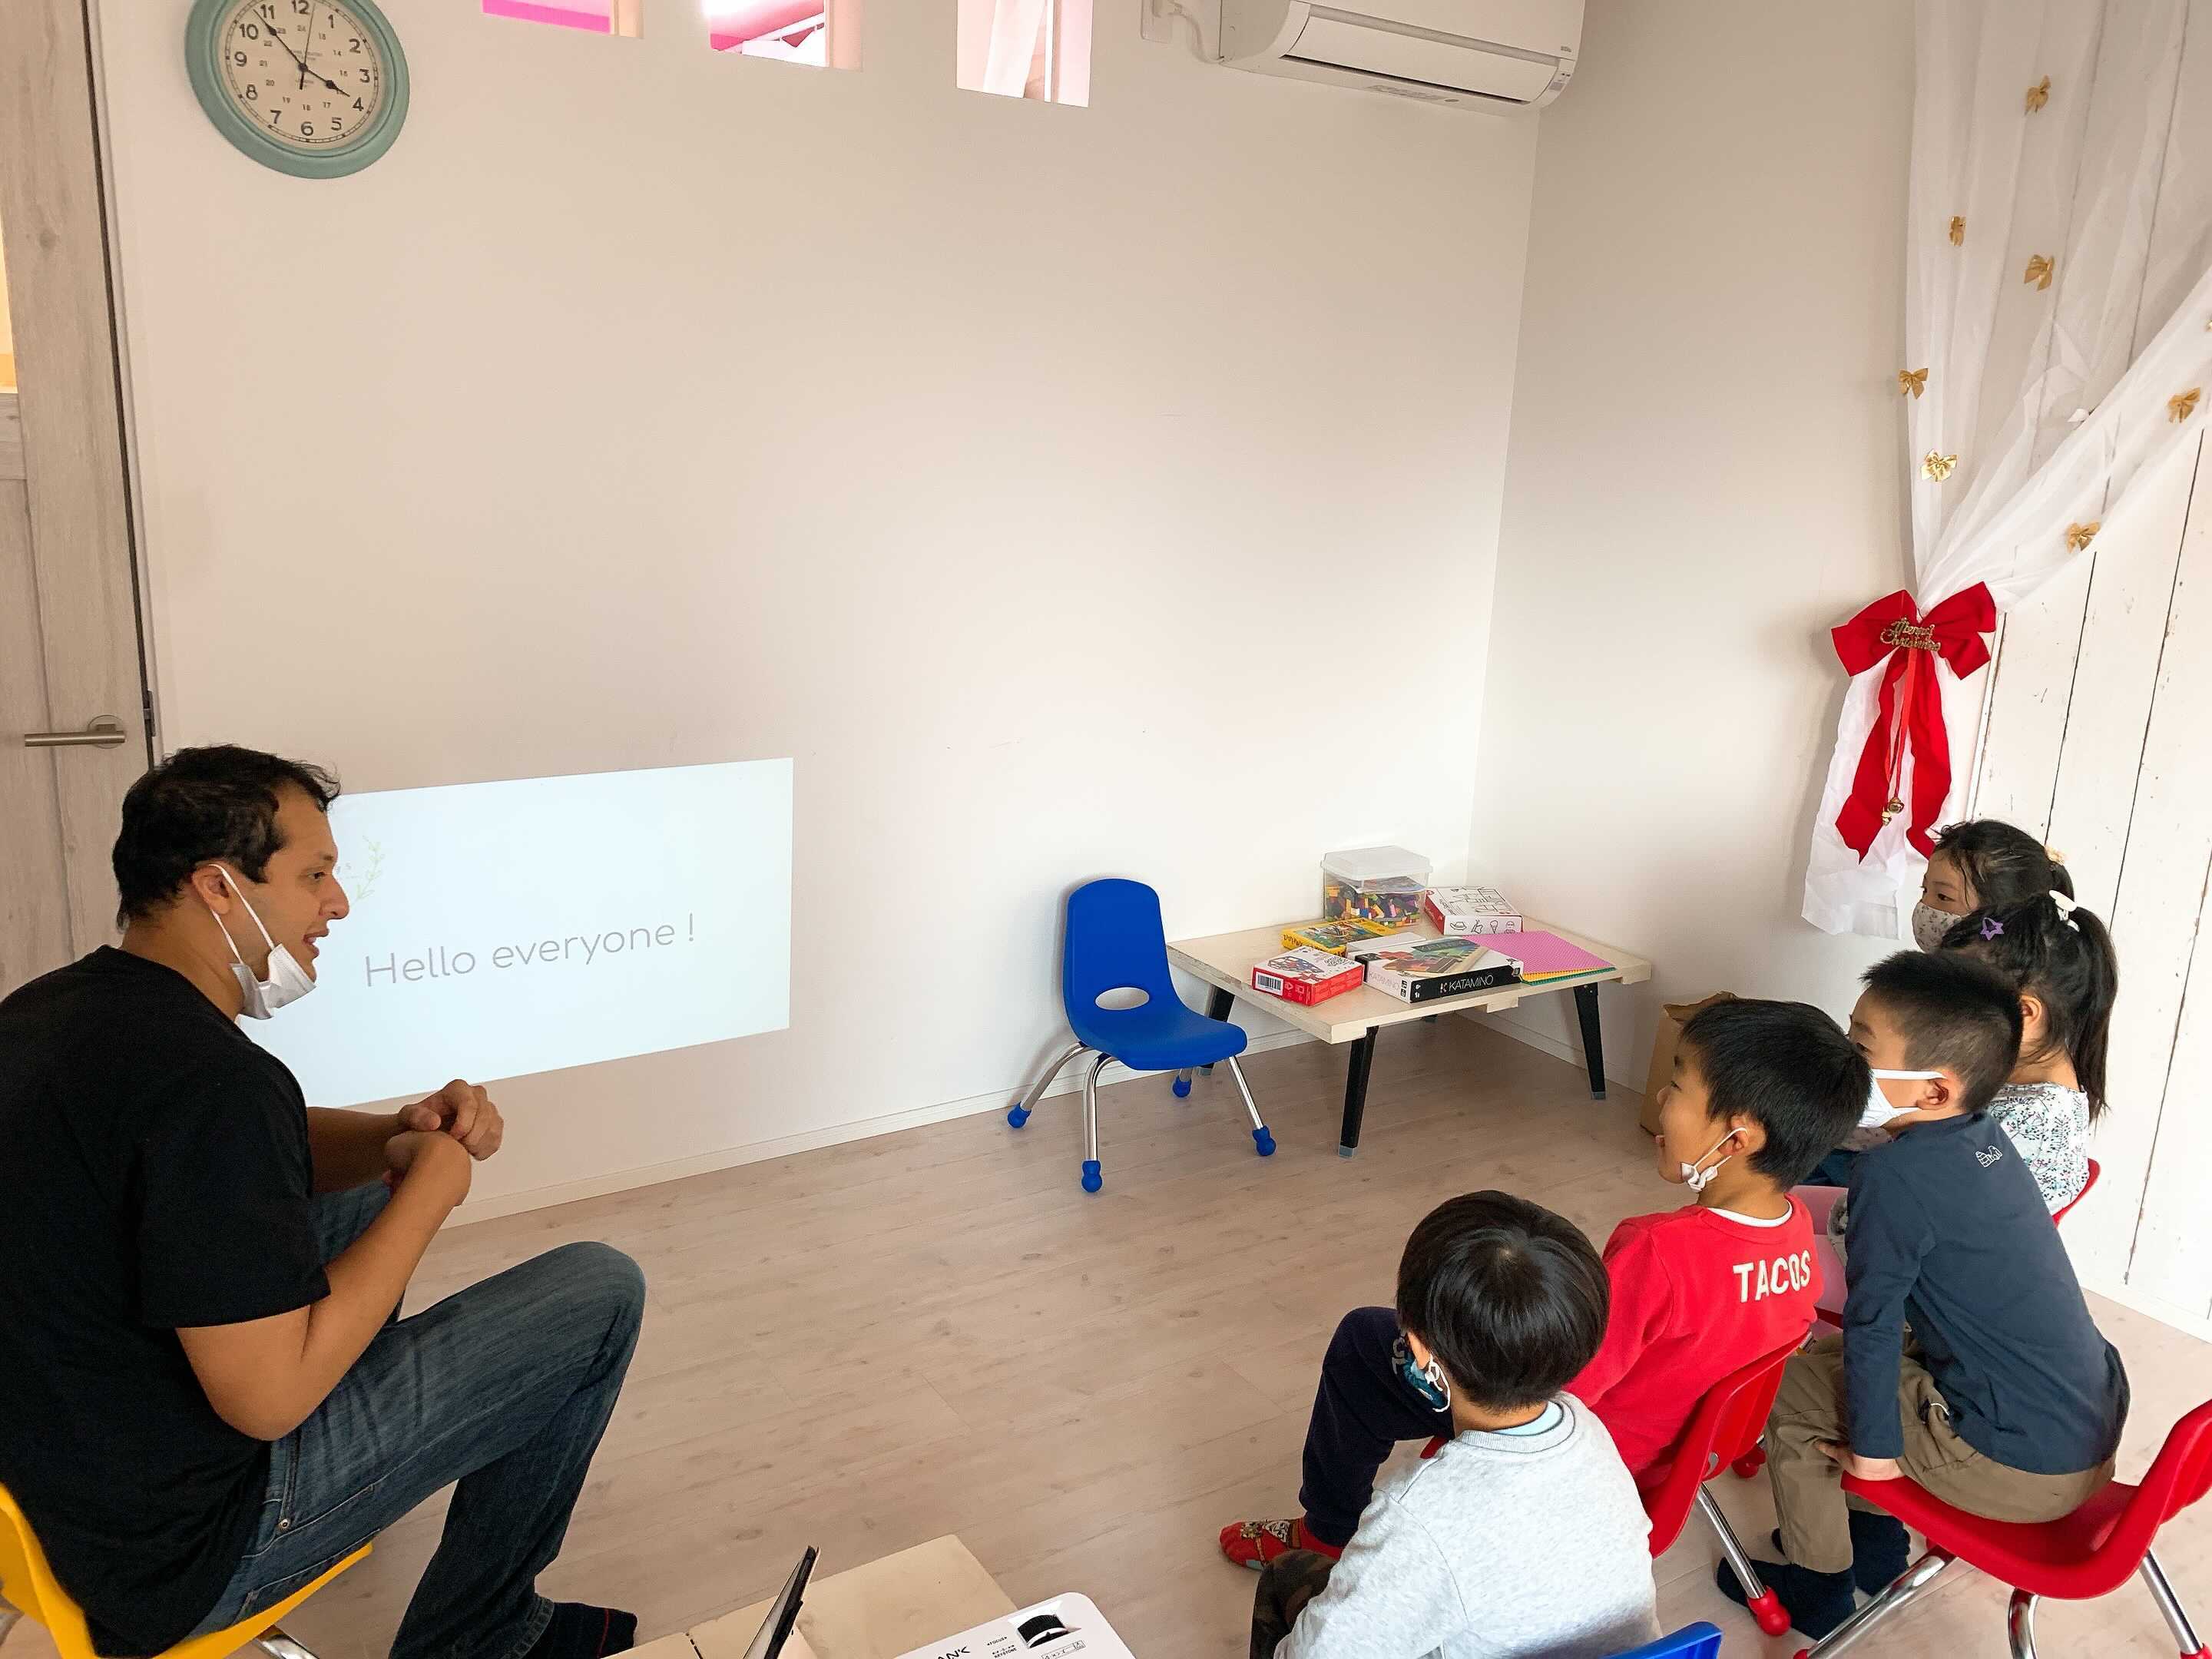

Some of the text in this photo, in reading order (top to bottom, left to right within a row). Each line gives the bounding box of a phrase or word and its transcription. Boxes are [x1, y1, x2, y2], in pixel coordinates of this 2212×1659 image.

[260, 4, 275, 19] 11
[292, 0, 310, 15] 12
[327, 14, 334, 28] 1
[239, 24, 258, 40] 10
[349, 38, 361, 54] 2
[234, 51, 247, 67] 9
[359, 68, 370, 83] 3
[246, 84, 258, 101] 8
[352, 97, 364, 111] 4
[270, 109, 282, 124] 7
[331, 117, 342, 131] 5
[300, 121, 313, 136] 6
[365, 912, 694, 987] Hello everyone !
[1449, 974, 1494, 992] KATAMINO
[1732, 1249, 1811, 1303] TACOS
